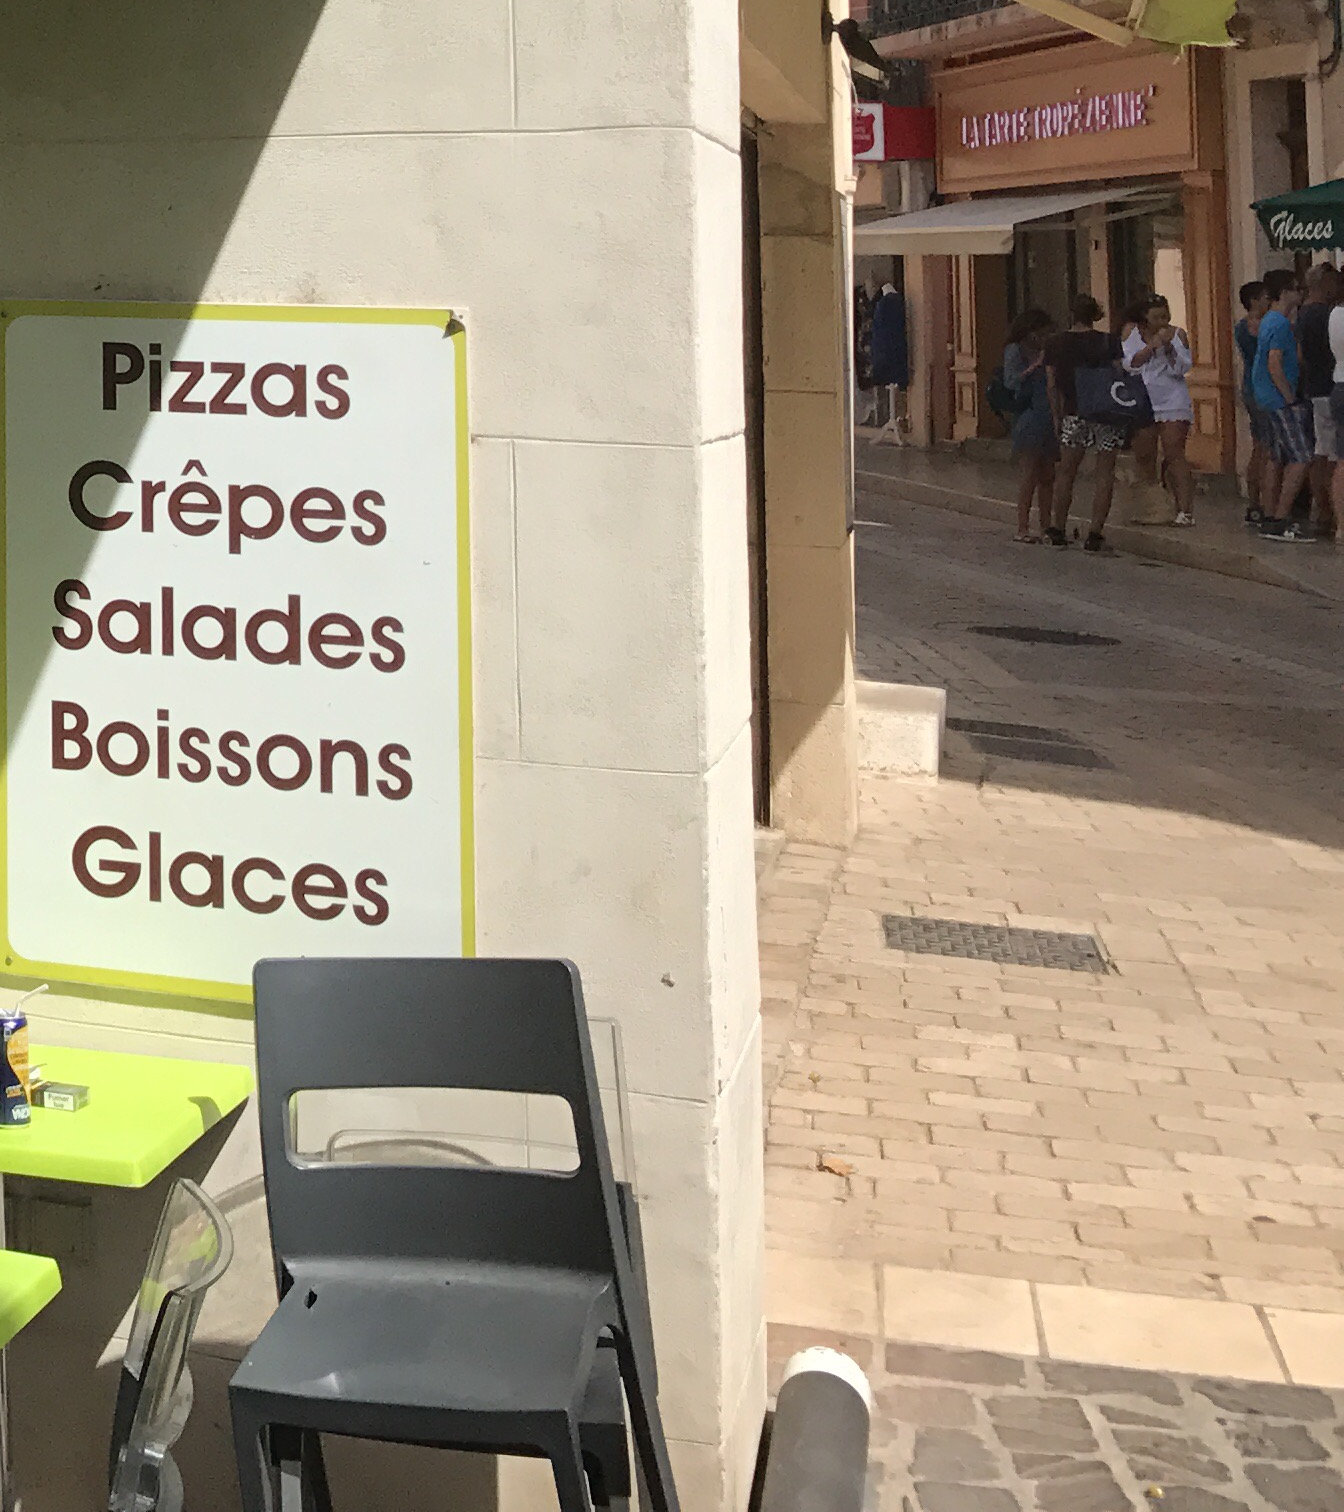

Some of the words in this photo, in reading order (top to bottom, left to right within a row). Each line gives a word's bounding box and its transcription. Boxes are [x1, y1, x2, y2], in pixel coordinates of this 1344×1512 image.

[1269, 210, 1335, 248] Glaces
[101, 341, 351, 421] Pizzas
[67, 459, 388, 555] Crêpes
[51, 578, 406, 673] Salades
[51, 700, 414, 801] Boissons
[71, 824, 390, 926] Glaces
